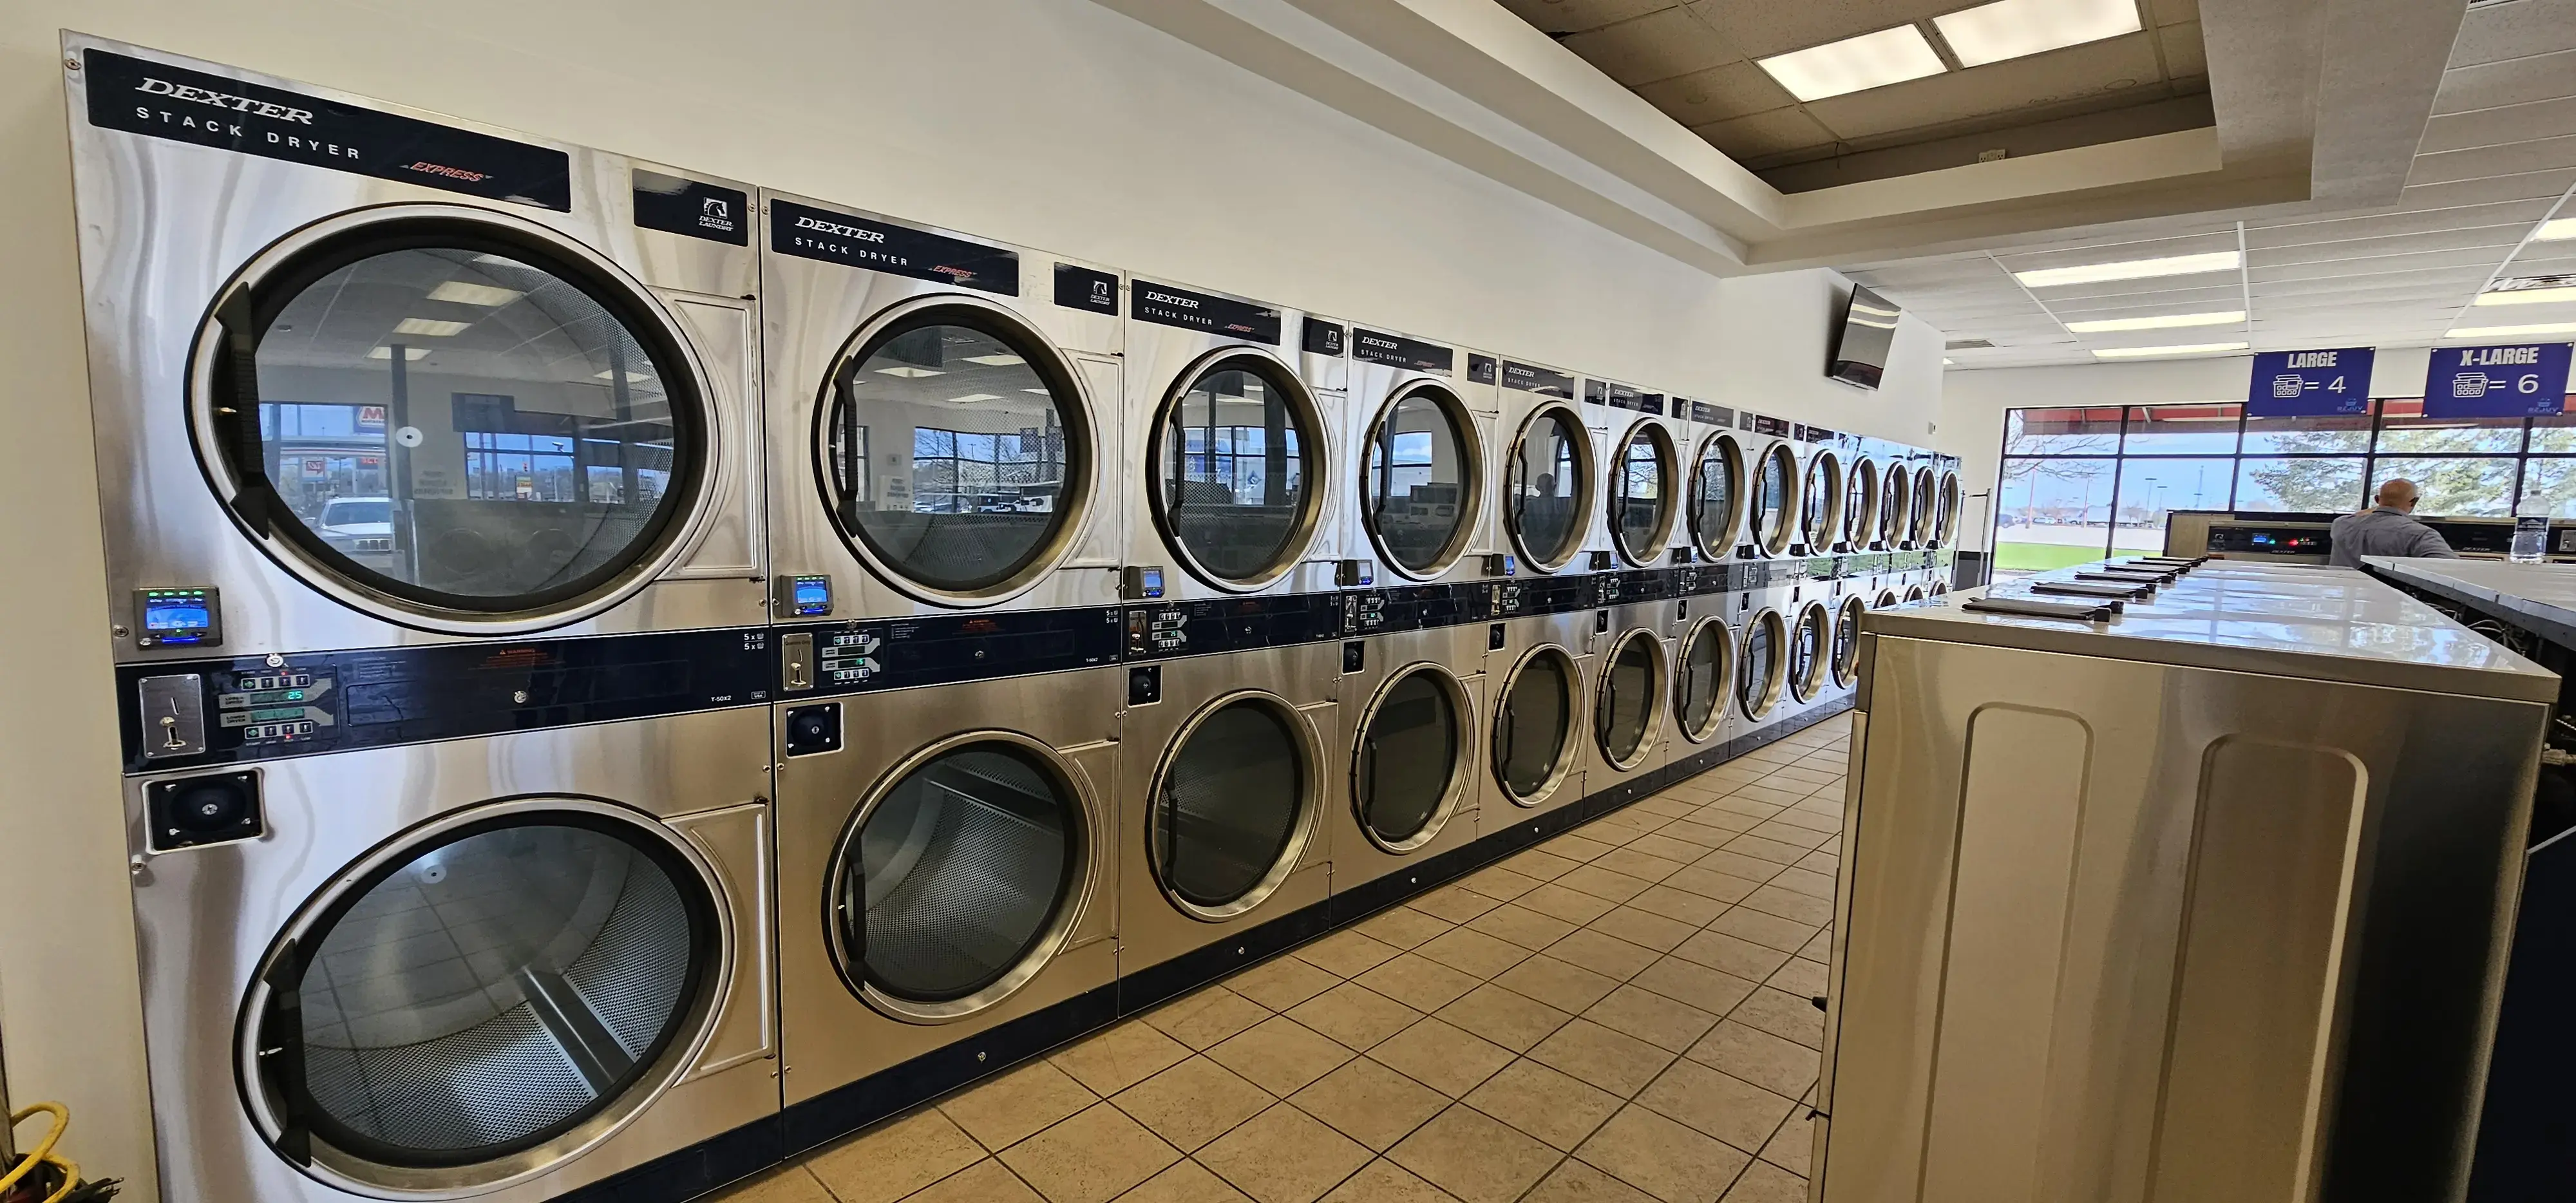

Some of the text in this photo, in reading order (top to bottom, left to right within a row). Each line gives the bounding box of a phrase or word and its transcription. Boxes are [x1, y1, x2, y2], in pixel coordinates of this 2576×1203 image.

[135, 77, 314, 125] DEXTER
[136, 107, 359, 160] STACK DRYER
[410, 162, 484, 182] EXPRESS
[699, 215, 733, 226] DEXTER
[699, 221, 734, 232] LAUNDRY
[795, 216, 885, 243] DEXTER
[795, 237, 907, 266] STACK DRYER
[933, 265, 973, 278] EXPRESS
[1145, 291, 1199, 309] DEXTER
[1144, 307, 1213, 326] STACK DRYER
[1361, 336, 1398, 350] DEXTER
[1361, 349, 1407, 363] STACK DRYER
[2287, 352, 2338, 368] LARGE
[2459, 347, 2539, 366] X-LARGE
[1508, 366, 1535, 378] DEXTER
[2327, 375, 2347, 393] 4
[2517, 374, 2539, 393] 6
[288, 691, 303, 699] 25
